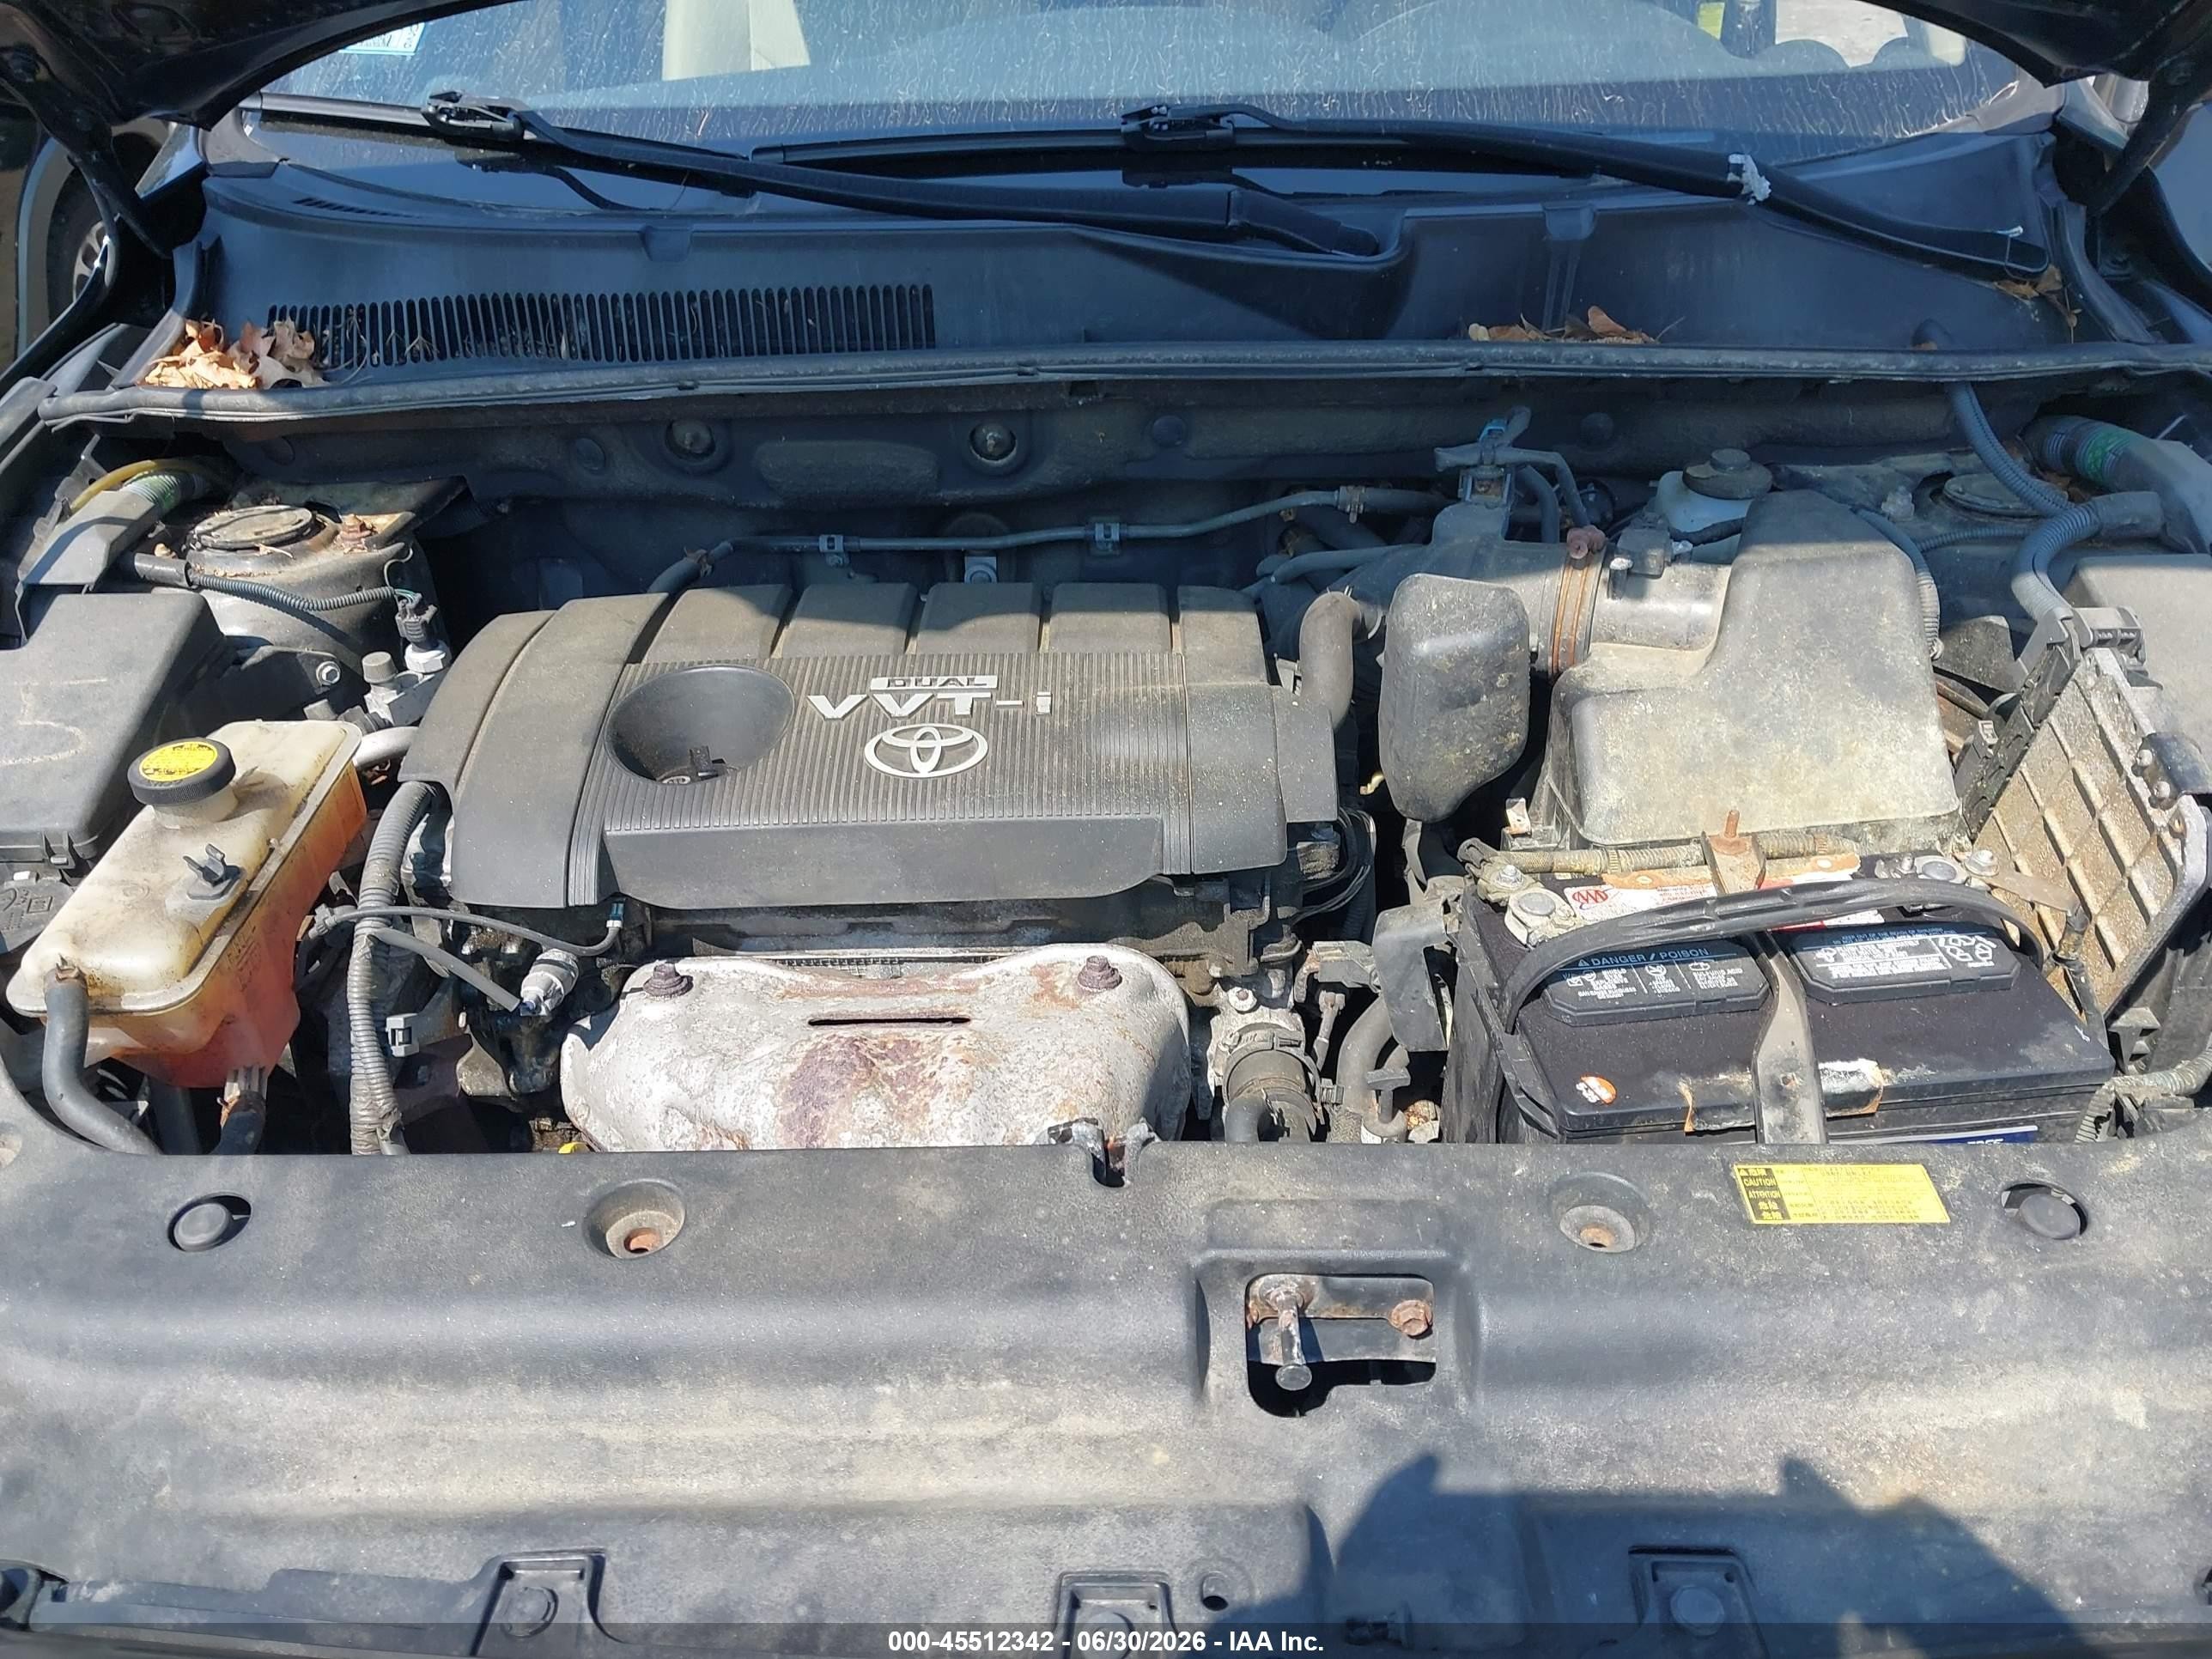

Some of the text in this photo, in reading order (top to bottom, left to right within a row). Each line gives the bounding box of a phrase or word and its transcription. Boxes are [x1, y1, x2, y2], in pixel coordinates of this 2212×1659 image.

[886, 677, 988, 688] DUAL
[807, 691, 1053, 720] VVT-i
[1591, 953, 1647, 966] DANGER
[1660, 948, 1711, 960] POISON
[1742, 1177, 1777, 1187] CAUTION
[1748, 1189, 1781, 1199] ATTENTION
